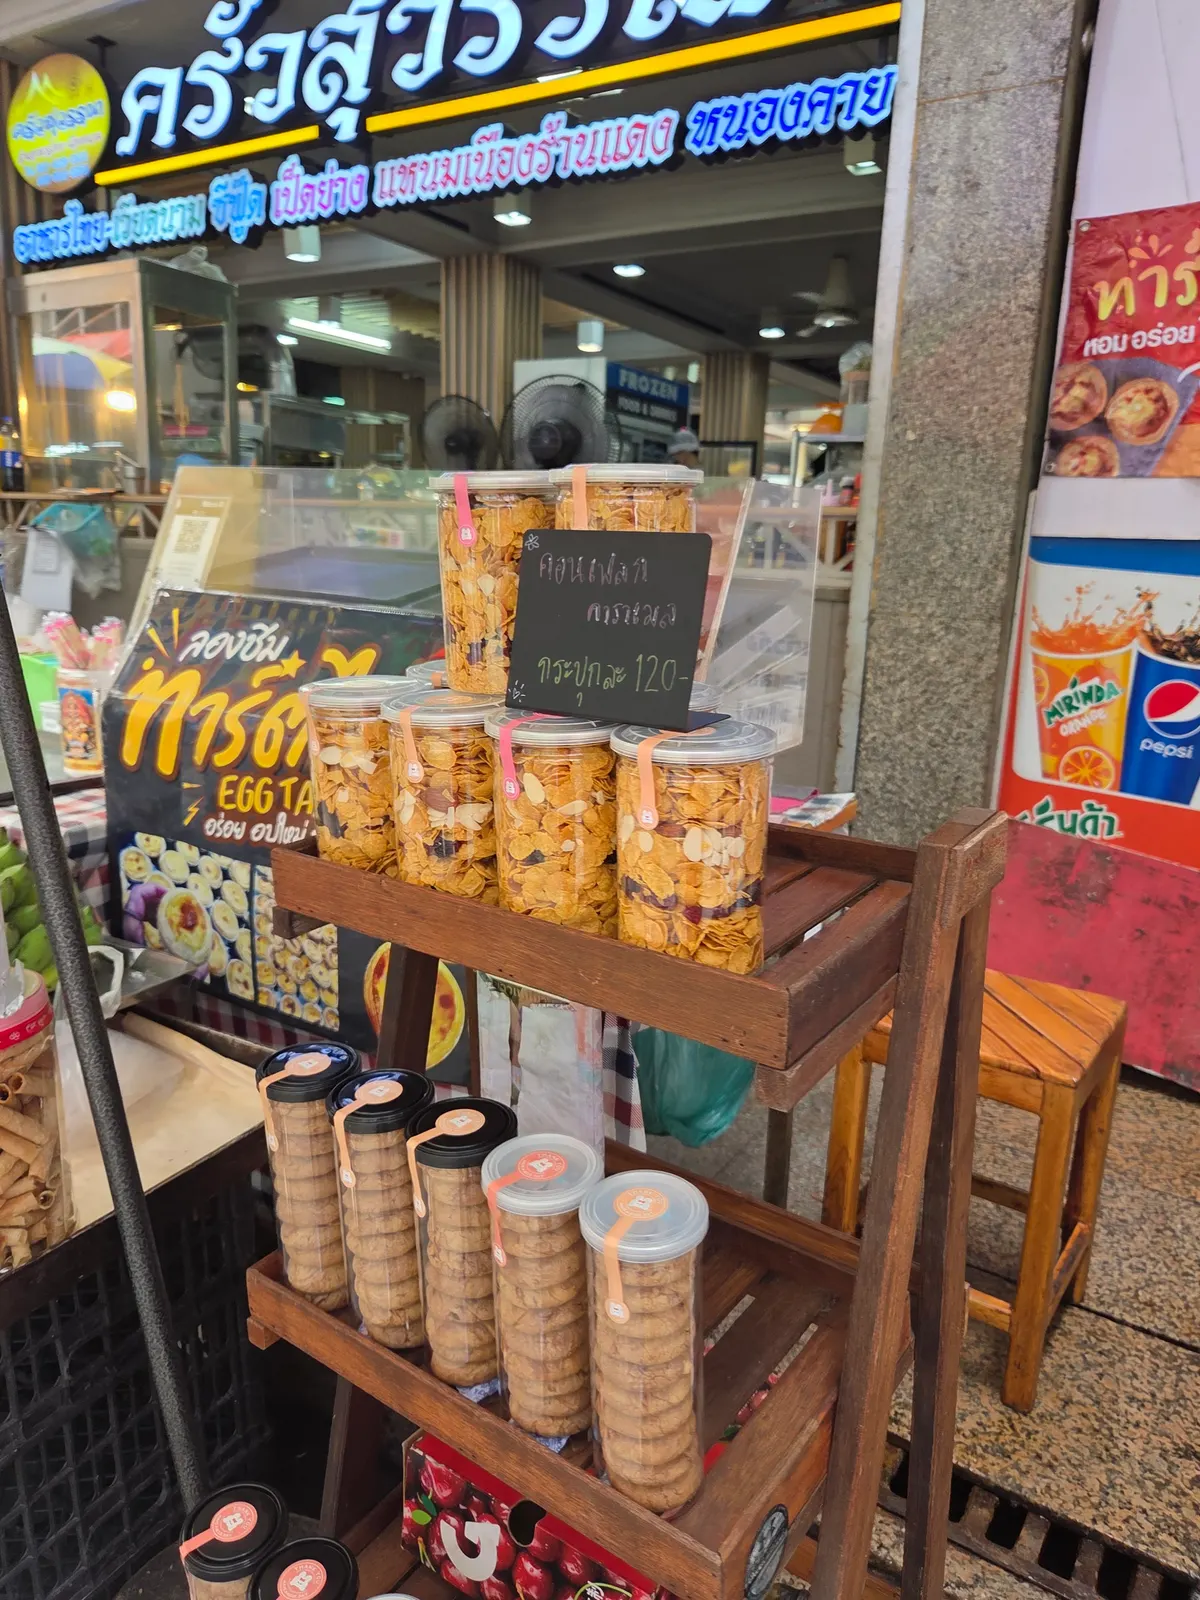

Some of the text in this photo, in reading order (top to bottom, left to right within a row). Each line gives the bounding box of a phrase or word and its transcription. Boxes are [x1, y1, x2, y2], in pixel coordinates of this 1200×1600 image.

[273, 158, 367, 222] เป็ดย่าง
[688, 67, 896, 151] หนองคาย
[1083, 321, 1196, 357] หอม อร่อย
[619, 368, 678, 403] FROZEN
[178, 621, 290, 663] ลองชิม
[538, 656, 627, 707] กระปุกละ
[1042, 676, 1122, 728] MIRINDA
[1139, 737, 1194, 760] pepsi
[217, 774, 314, 817] EGG TA
[204, 812, 247, 840] อร่อย
